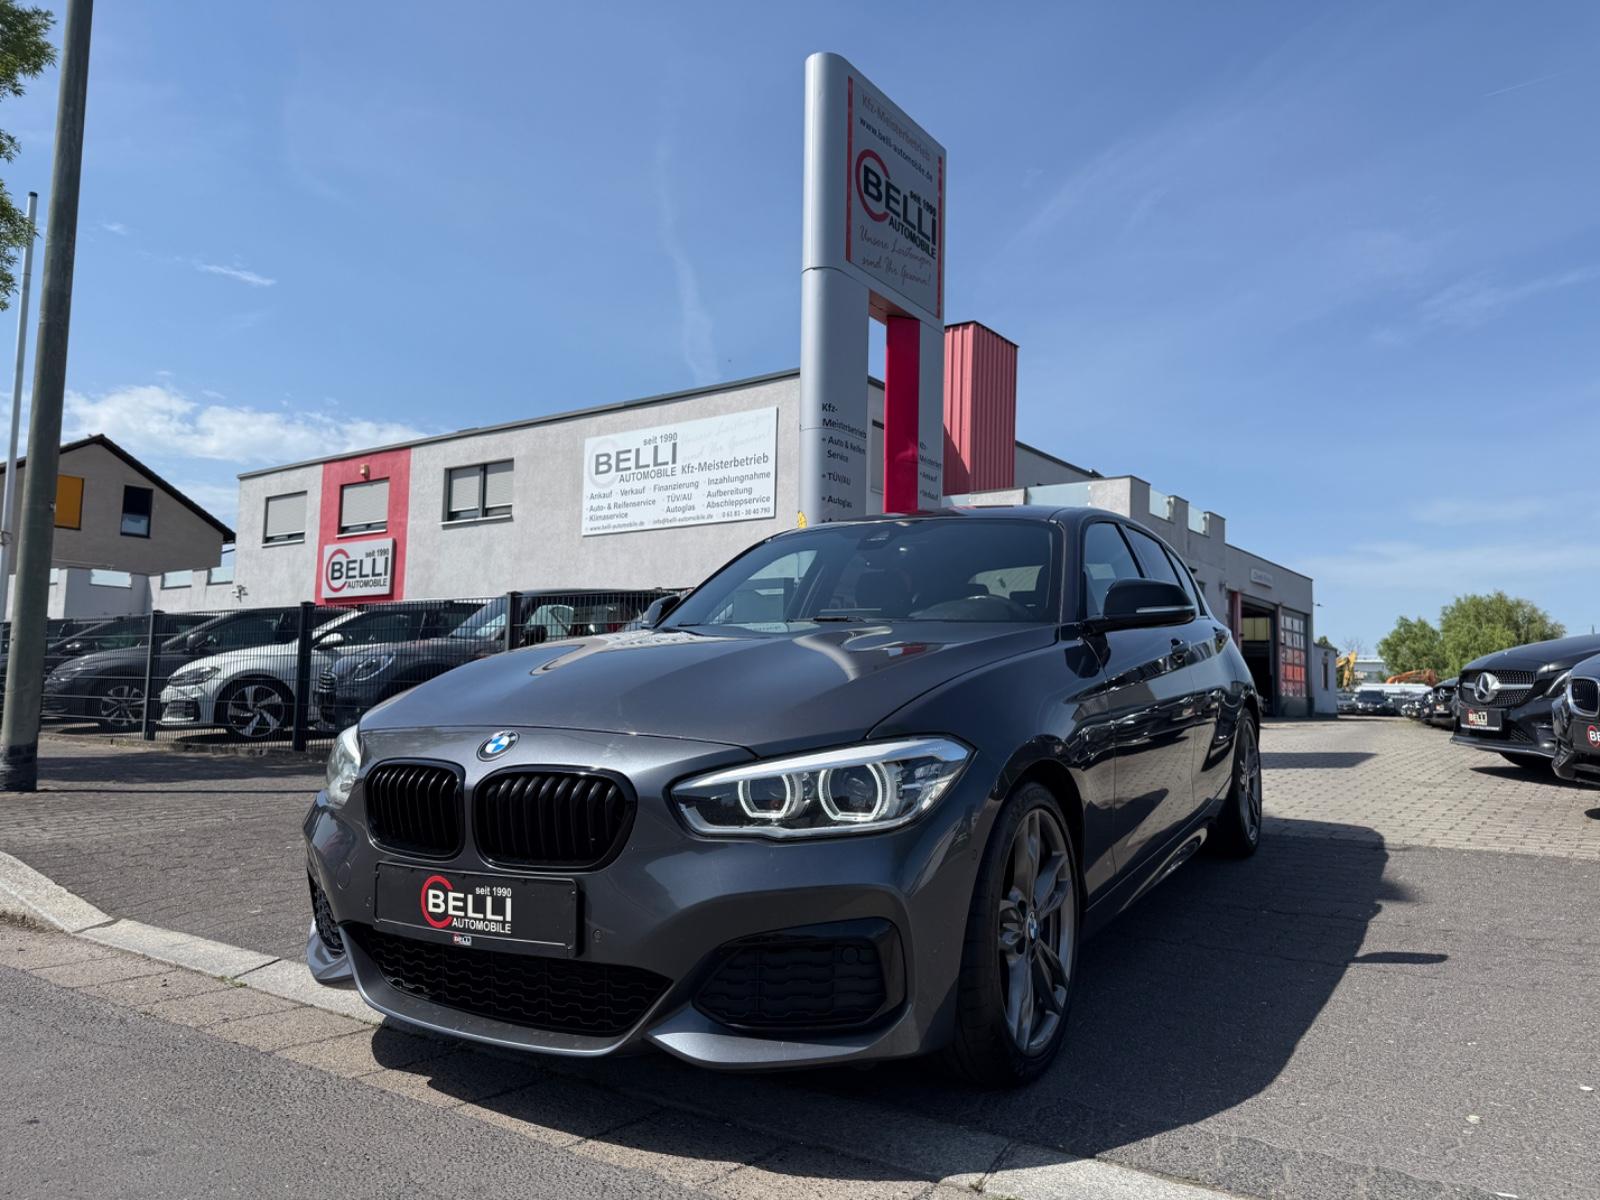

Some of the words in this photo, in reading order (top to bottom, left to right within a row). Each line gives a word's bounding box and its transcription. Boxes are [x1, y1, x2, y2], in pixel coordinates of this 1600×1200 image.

[863, 164, 936, 246] BELLI
[889, 216, 936, 260] AUTOMOBILE
[822, 403, 838, 413] Kfz-
[822, 418, 867, 439] Meisterbetrieb
[643, 436, 657, 446] seit
[660, 433, 678, 443] 1990
[828, 436, 844, 447] Auto
[594, 442, 677, 475] BELLI
[681, 453, 769, 474] Kfz-Meisterbetrieb
[827, 450, 849, 463] Service
[619, 467, 676, 483] AUTOMOBILE
[589, 490, 613, 500] Ankauf
[620, 487, 646, 497] Verkauf
[653, 480, 699, 493] Finanzierung
[707, 471, 771, 486] Inzahlungnahme
[706, 487, 753, 500] Aufbereitung
[613, 498, 656, 510] Reifenservice
[706, 495, 771, 511] Abschleppservice
[589, 511, 628, 522] Klimaservice
[365, 550, 376, 558] seit
[377, 548, 389, 556] 1990
[330, 557, 388, 580] BELLI
[347, 578, 387, 589] AUTOMOBILE
[475, 886, 491, 896] seit
[492, 886, 512, 897] 1990
[427, 889, 512, 922] BELLI
[452, 918, 512, 934] AUTOMOBILE
